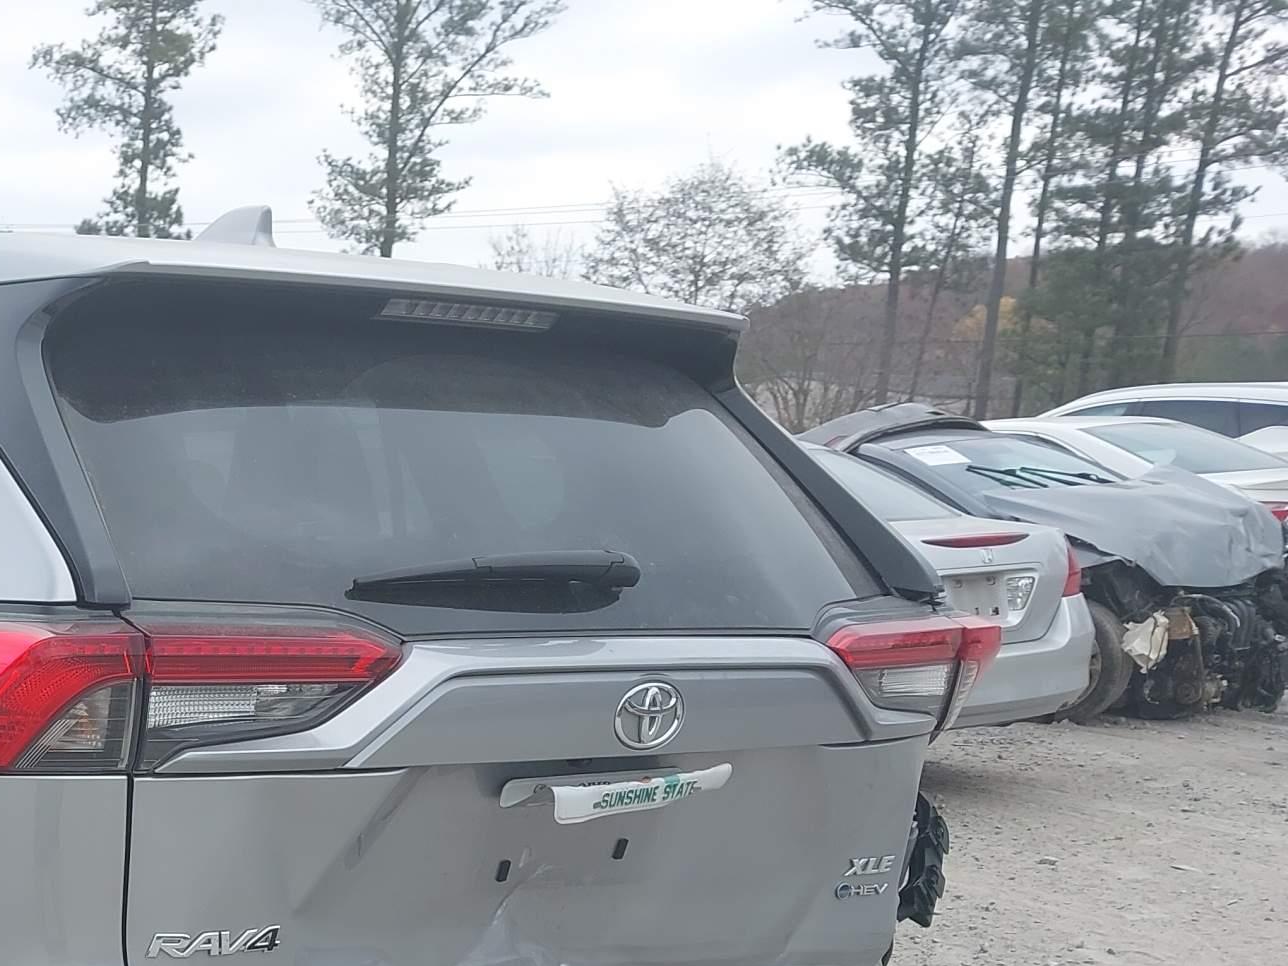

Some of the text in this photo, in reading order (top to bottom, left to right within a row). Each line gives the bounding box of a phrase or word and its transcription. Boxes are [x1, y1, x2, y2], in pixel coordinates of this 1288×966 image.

[600, 785, 660, 809] SUNSHINE
[843, 855, 896, 877] XLE
[146, 924, 281, 958] RAV4
